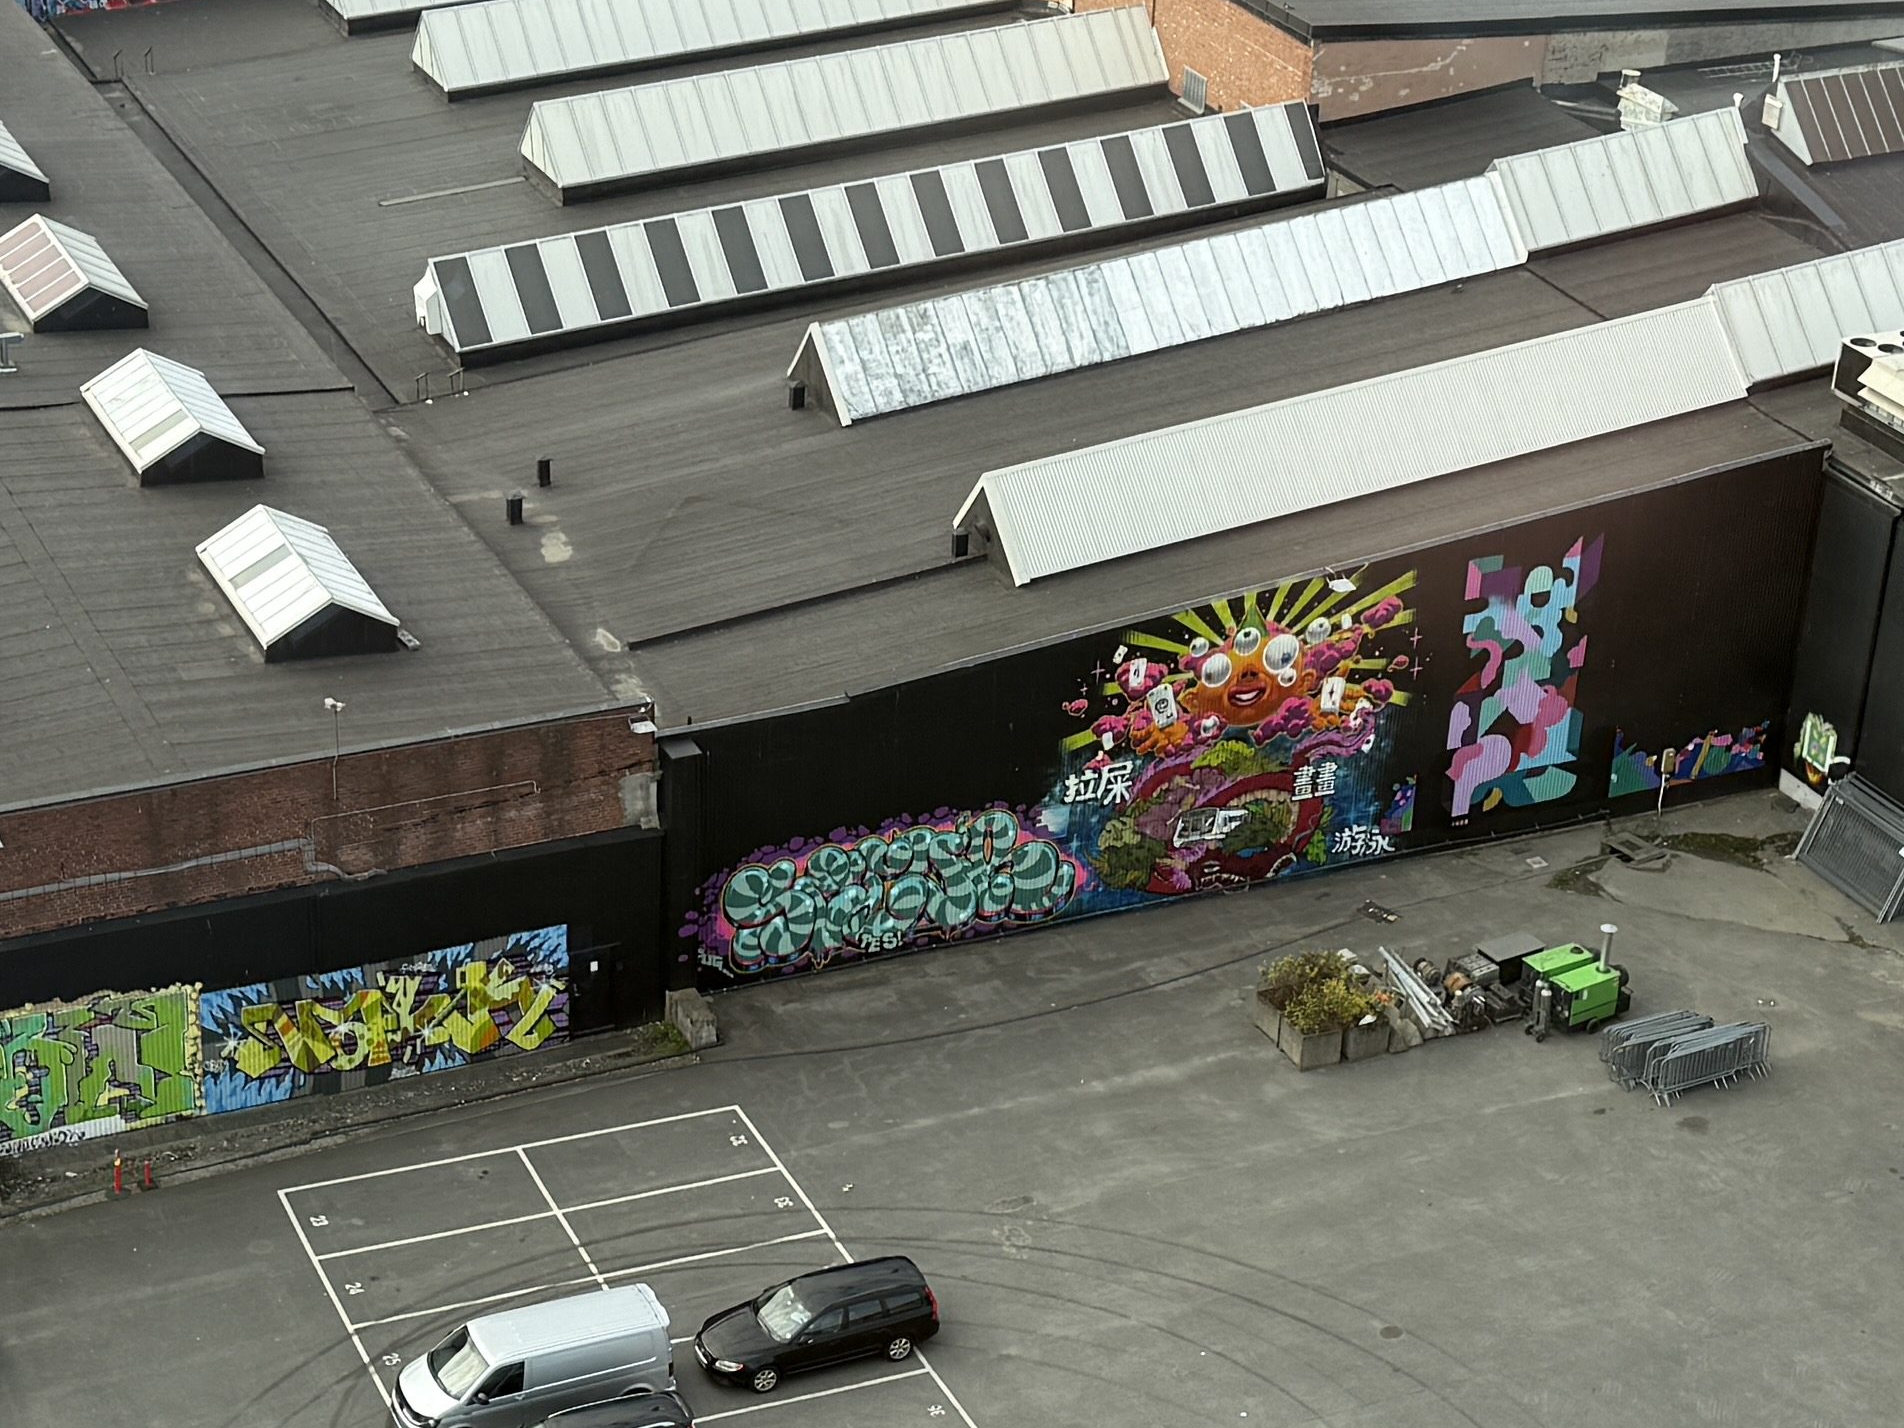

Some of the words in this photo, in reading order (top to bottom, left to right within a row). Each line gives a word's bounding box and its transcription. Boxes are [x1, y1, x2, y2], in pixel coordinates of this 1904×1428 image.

[1063, 760, 1134, 806] 拉屎
[1292, 761, 1338, 801] 畫畫
[1331, 824, 1396, 857] 游泳
